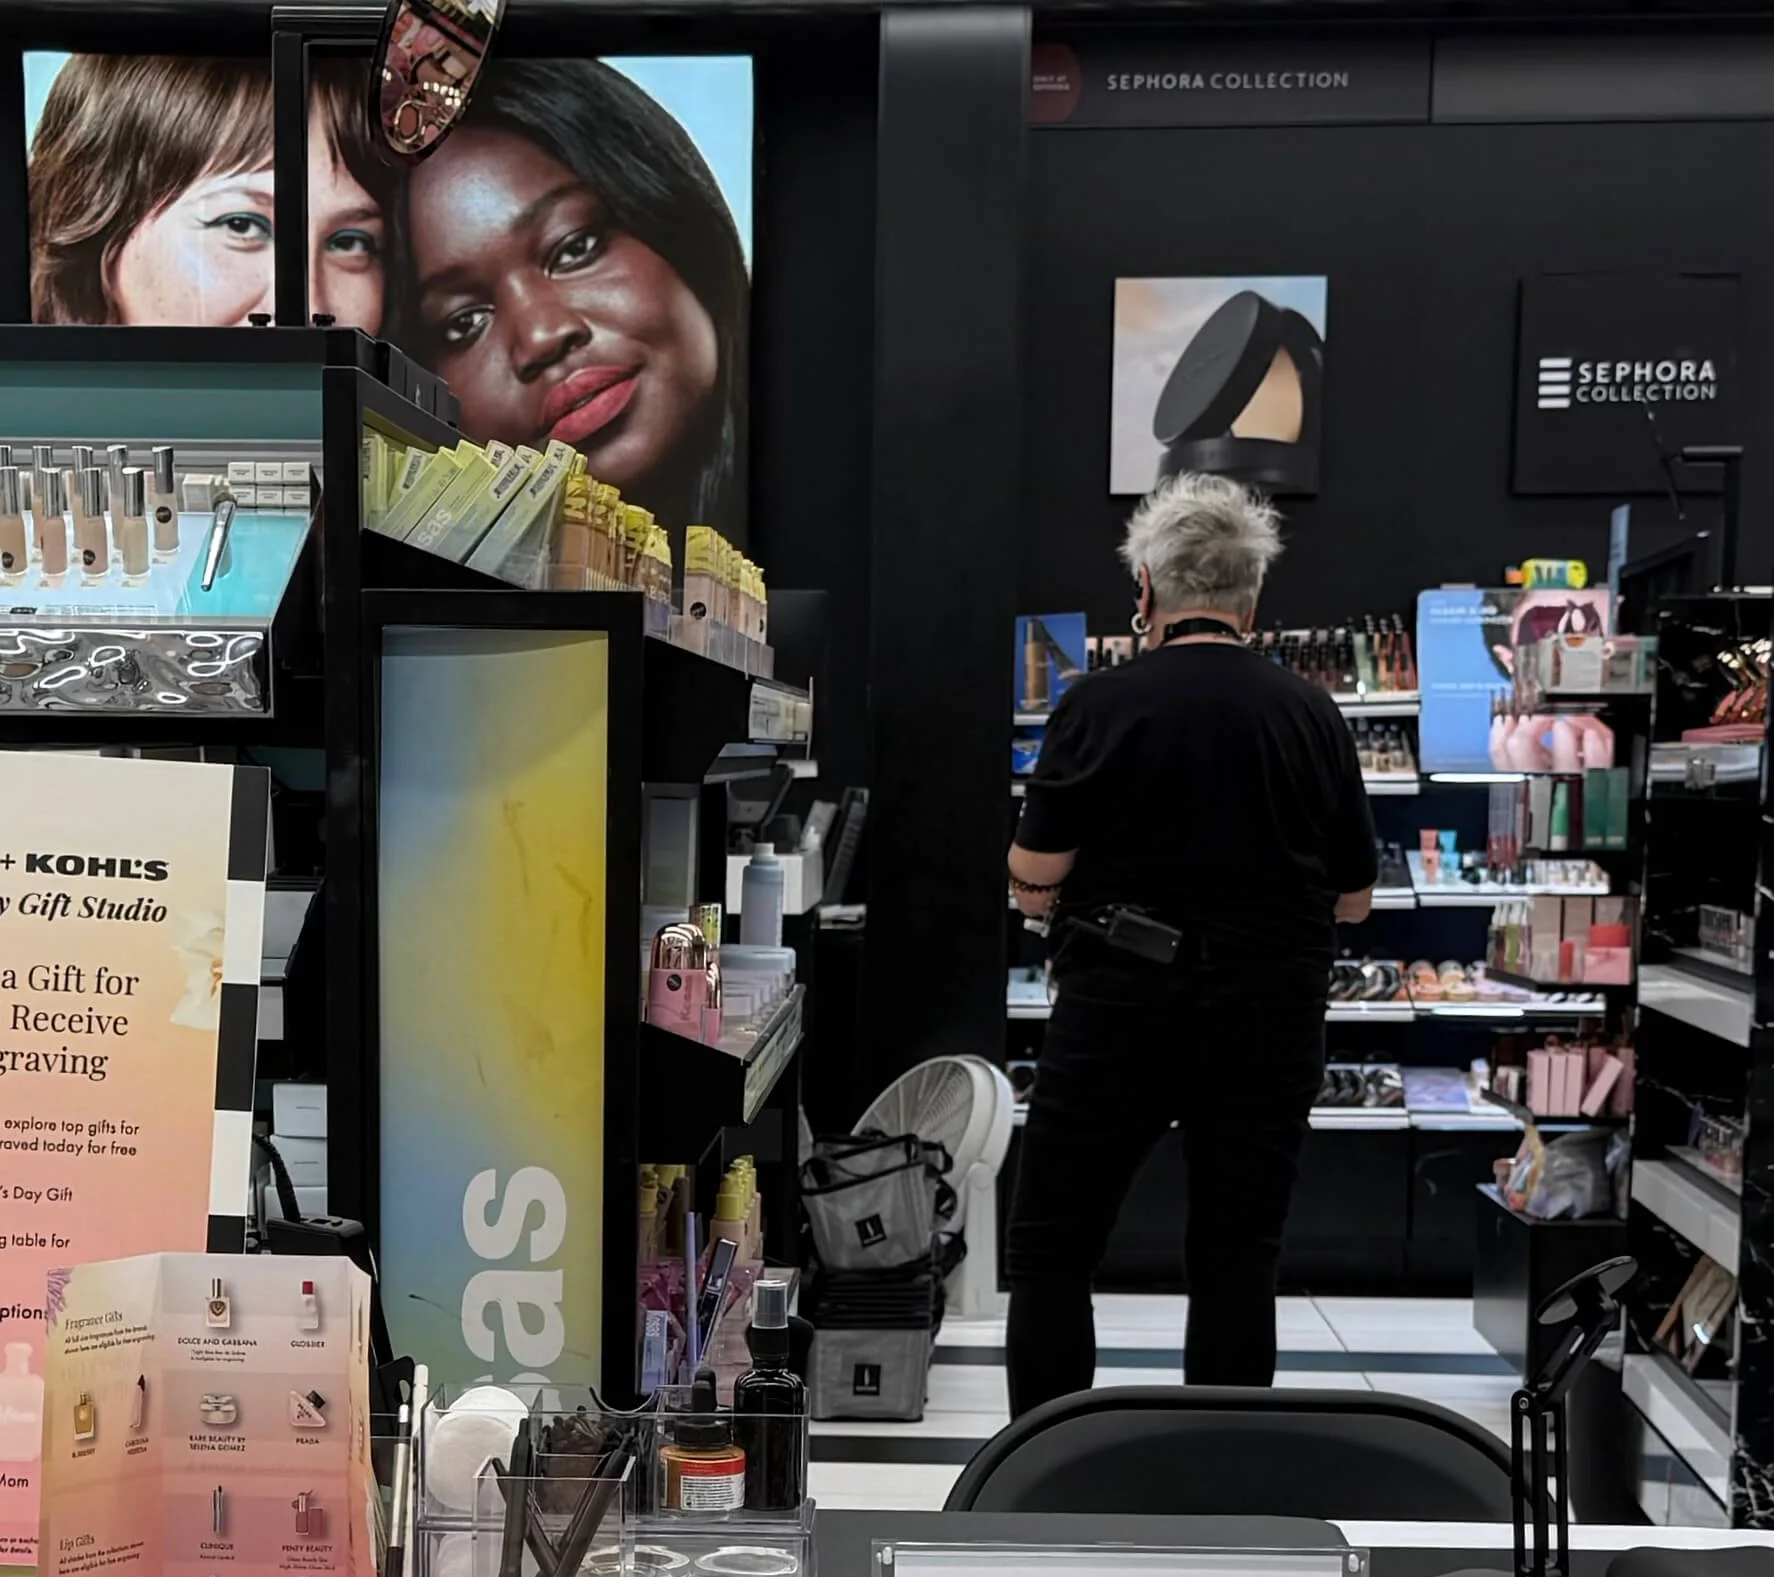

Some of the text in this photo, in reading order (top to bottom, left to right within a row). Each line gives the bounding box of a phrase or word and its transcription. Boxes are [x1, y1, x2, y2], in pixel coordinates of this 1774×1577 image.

[1107, 72, 1349, 90] SEPHORA COLLECTION
[1578, 360, 1716, 384] SEPHORA
[1576, 384, 1717, 402] COLLECTION
[26, 854, 170, 881] KOHL'S
[18, 892, 71, 921] Gift
[77, 896, 168, 922] Studio
[1, 964, 140, 995] a Gift for
[9, 1004, 128, 1036] Receive
[4, 1116, 140, 1137] explore top gifts for
[43, 1138, 84, 1156] today
[87, 1139, 107, 1154] for
[110, 1140, 137, 1156] free
[13, 1186, 42, 1204] Day
[46, 1187, 73, 1201] Gift
[11, 1232, 47, 1247] table
[51, 1233, 70, 1248] for
